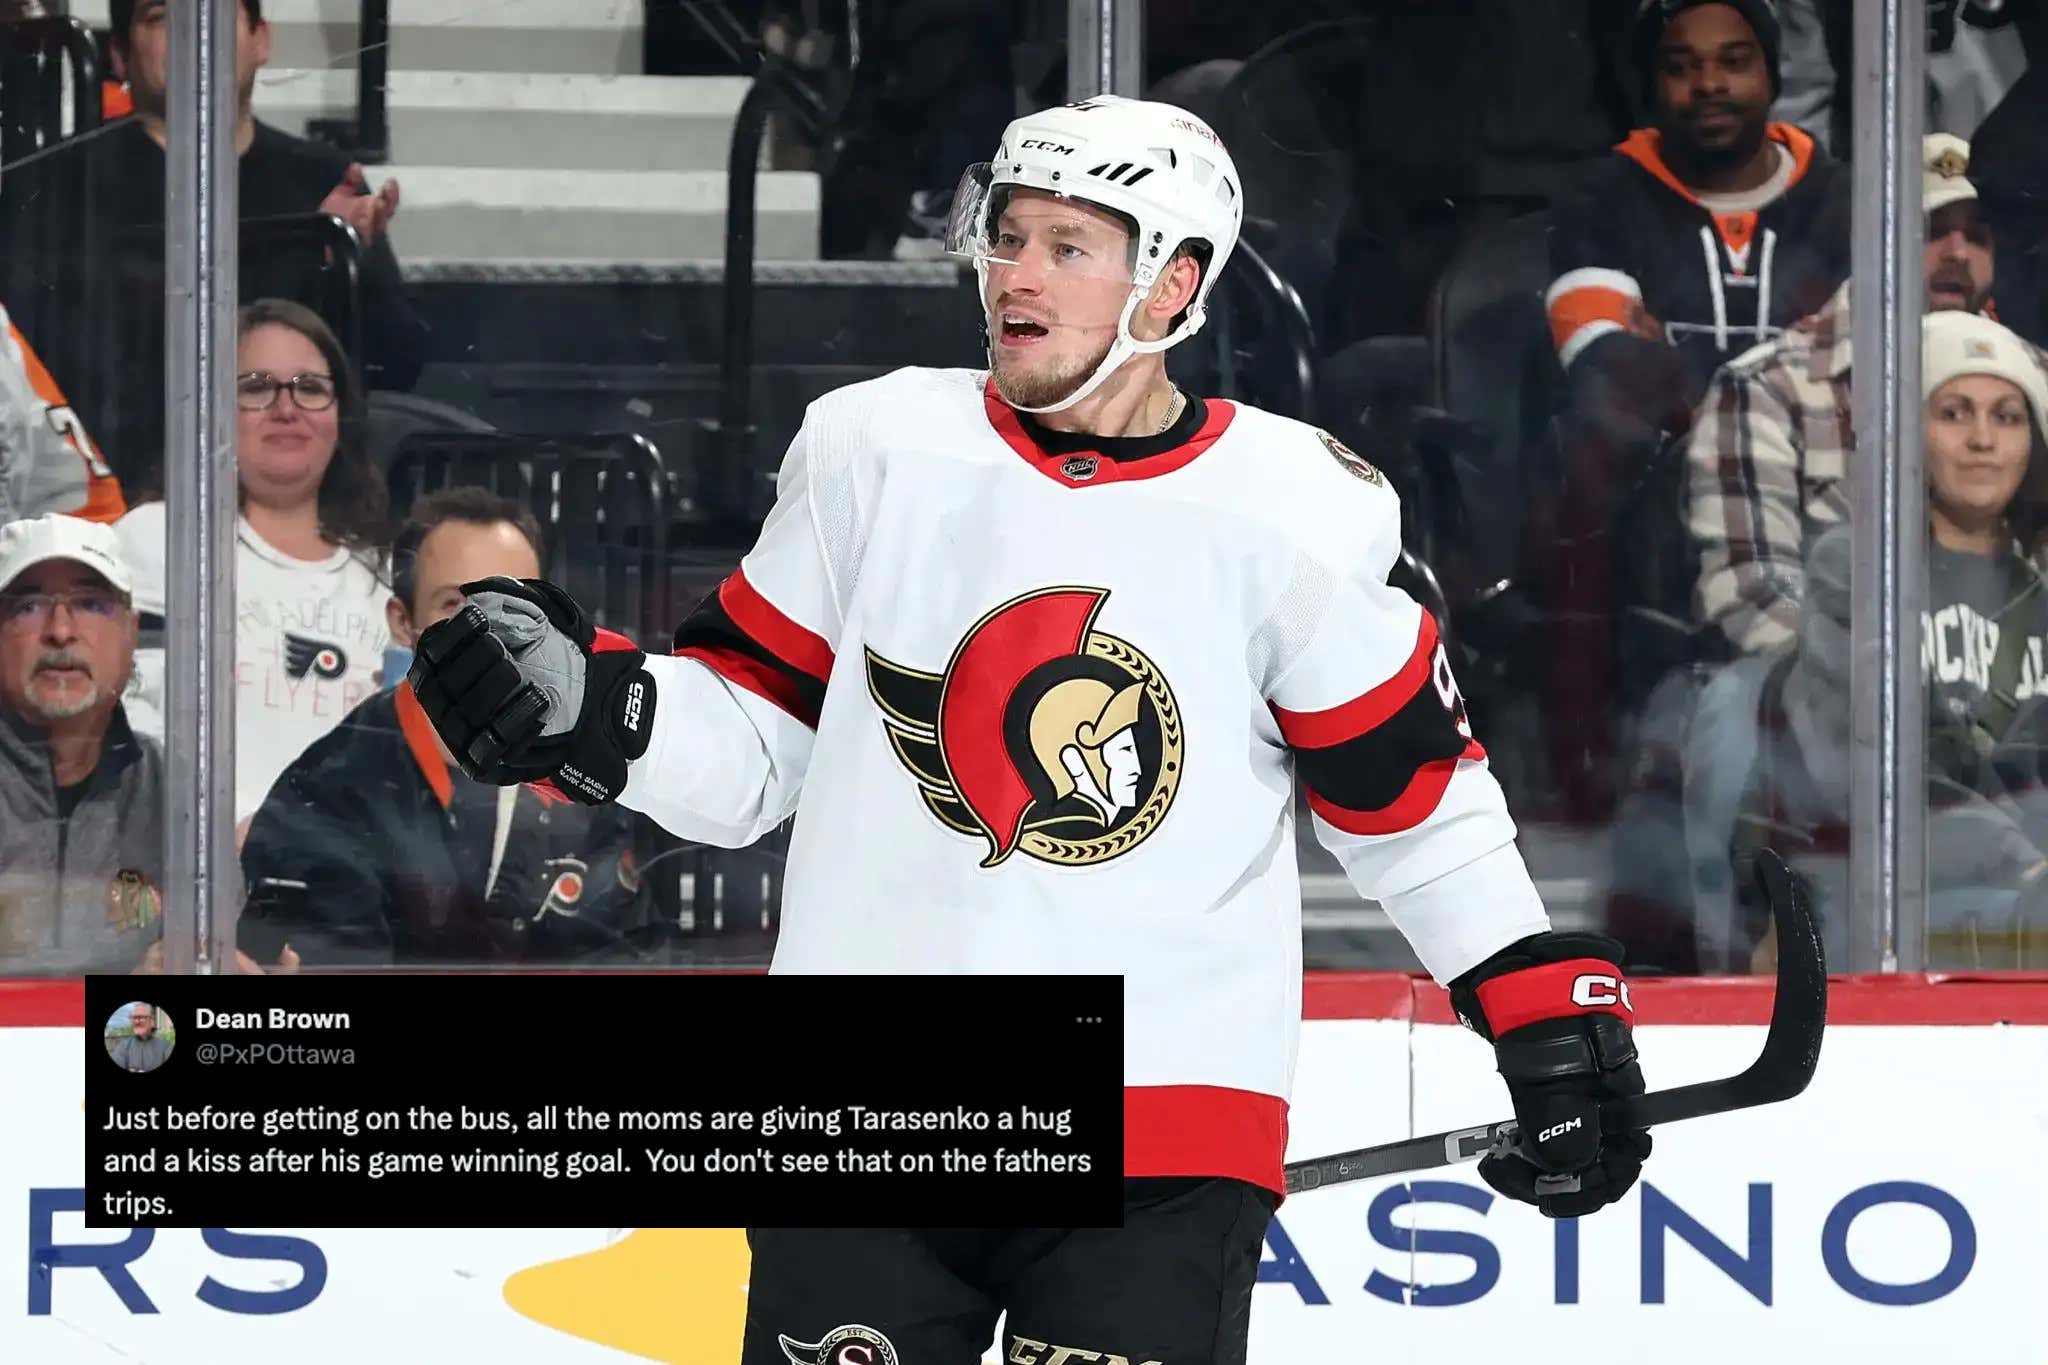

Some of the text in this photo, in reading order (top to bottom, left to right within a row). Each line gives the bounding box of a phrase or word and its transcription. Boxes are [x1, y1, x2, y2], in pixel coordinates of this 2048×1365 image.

[1020, 139, 1075, 156] CCM
[628, 682, 644, 732] CCM
[1539, 1117, 1582, 1142] CCM
